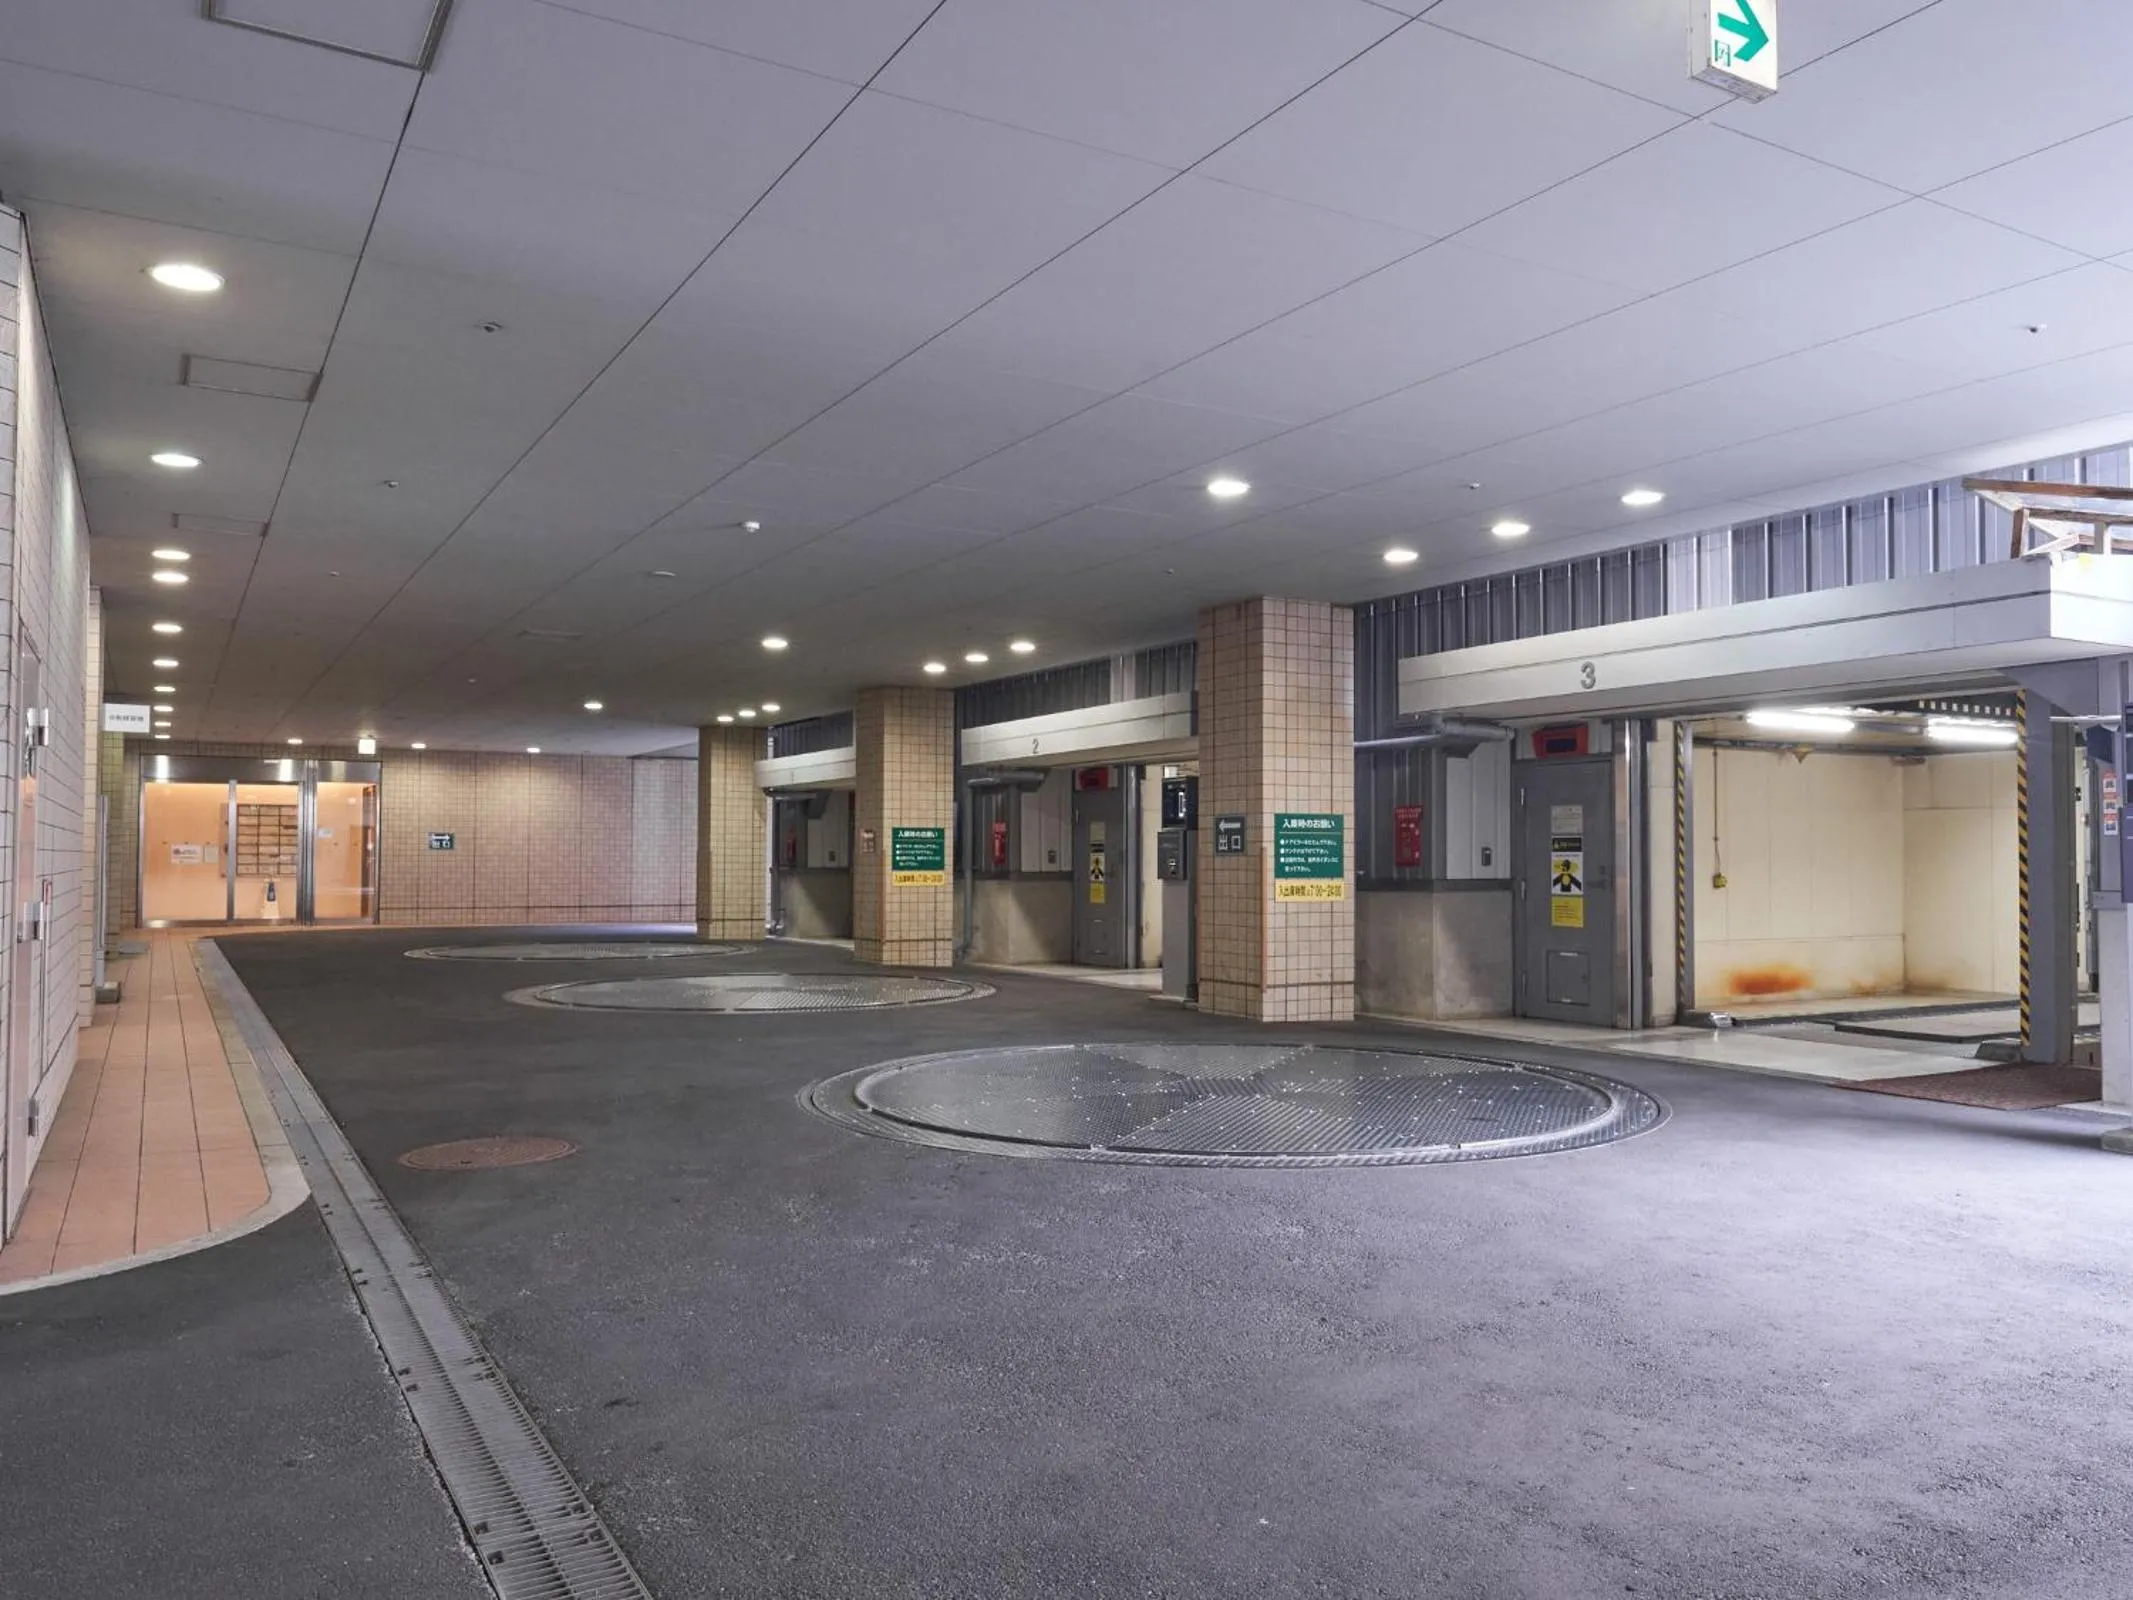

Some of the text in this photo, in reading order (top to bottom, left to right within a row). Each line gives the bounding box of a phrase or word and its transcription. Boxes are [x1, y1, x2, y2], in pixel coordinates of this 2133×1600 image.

[1580, 661, 1596, 689] 3
[1032, 738, 1040, 754] 2
[1218, 834, 1241, 851] 出口
